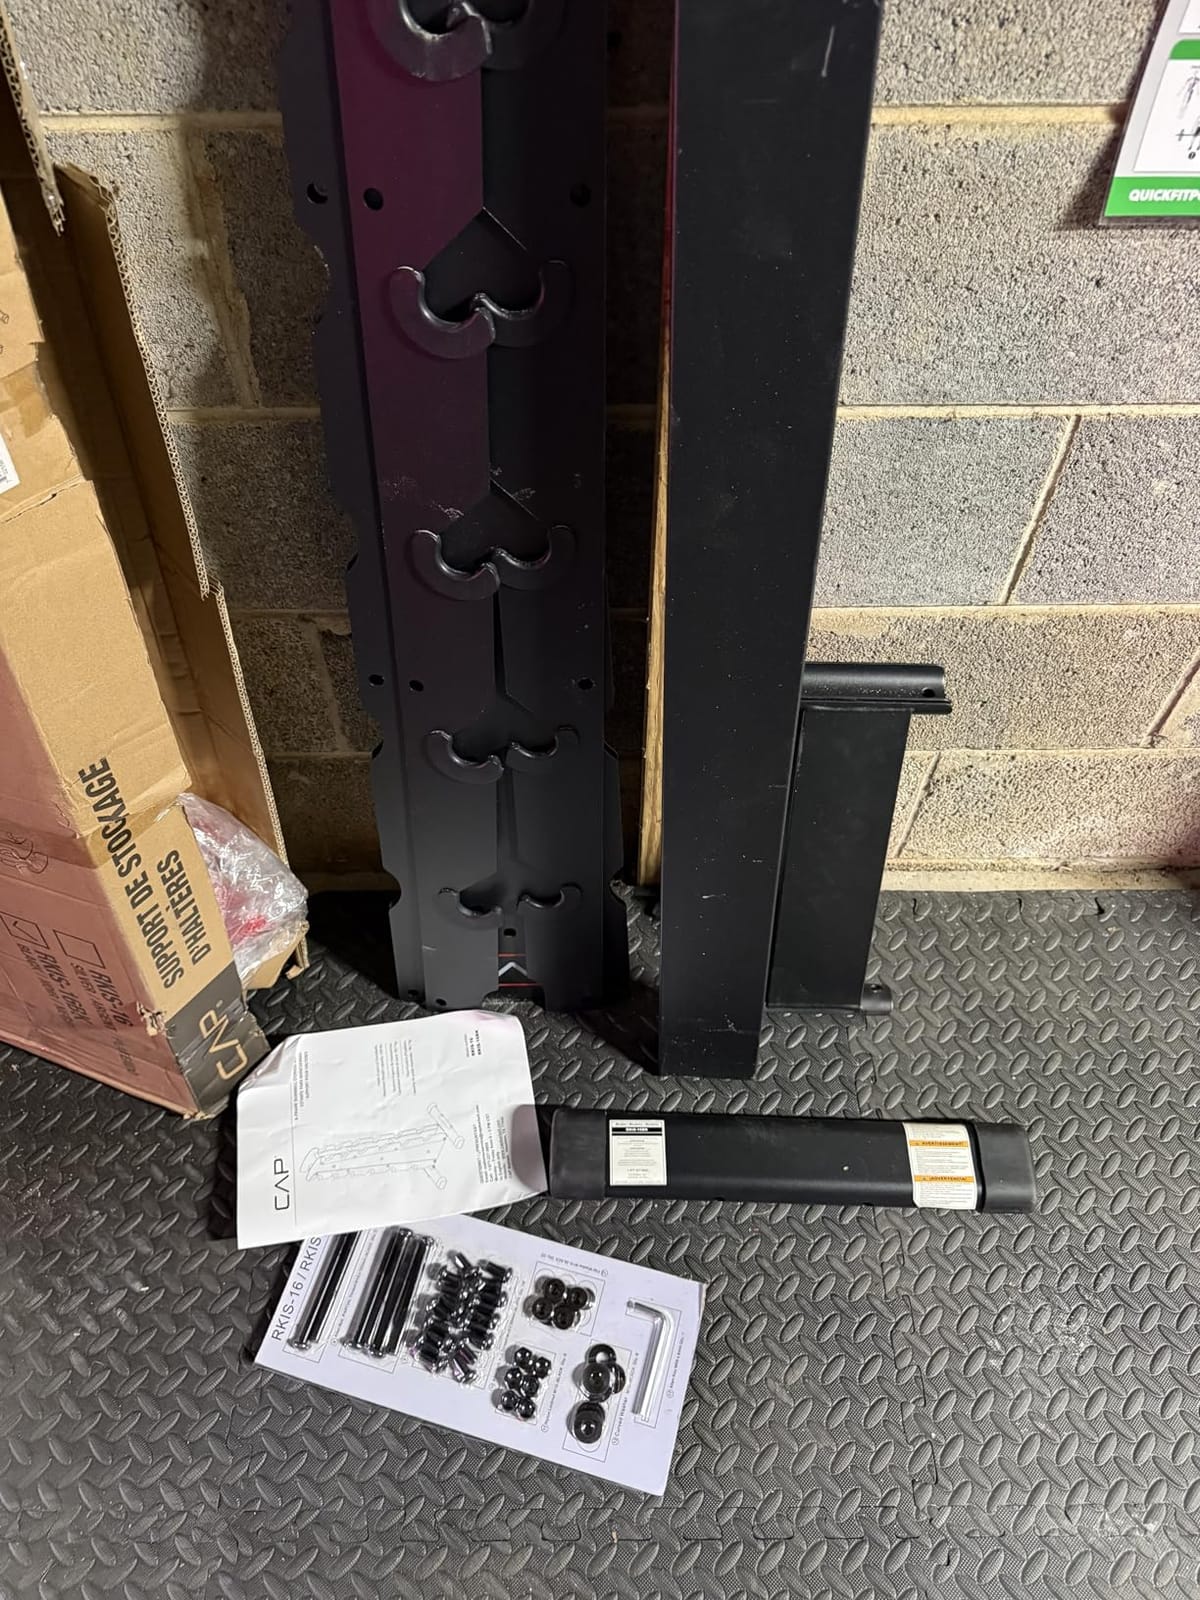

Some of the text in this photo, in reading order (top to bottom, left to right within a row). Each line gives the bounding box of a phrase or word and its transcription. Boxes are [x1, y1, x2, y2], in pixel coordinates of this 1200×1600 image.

[1128, 188, 1200, 202] QUICKFITP
[78, 756, 185, 989] SUPPORT DE STOCKAGE
[156, 849, 212, 966] D'HALTÈRES
[199, 1009, 248, 1080] CAP
[273, 1158, 290, 1211] CAP
[271, 1281, 304, 1341] RKIS-16
